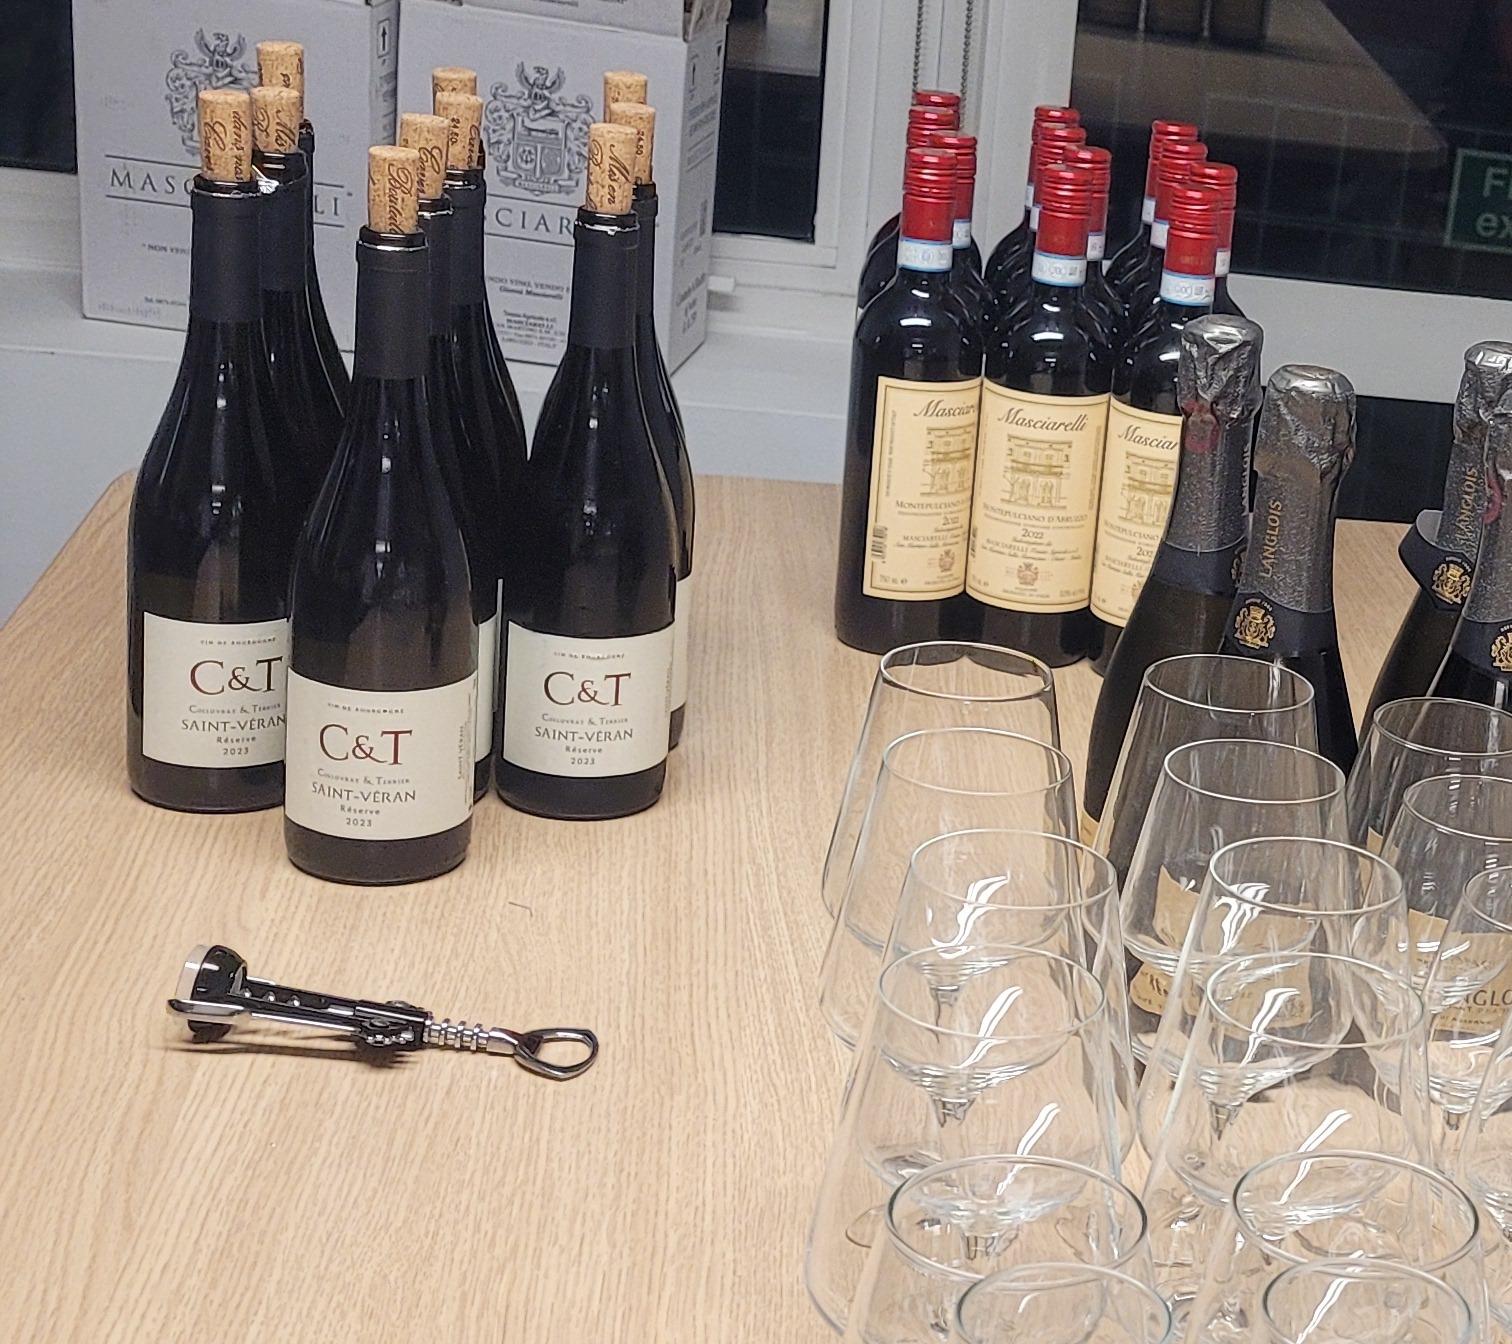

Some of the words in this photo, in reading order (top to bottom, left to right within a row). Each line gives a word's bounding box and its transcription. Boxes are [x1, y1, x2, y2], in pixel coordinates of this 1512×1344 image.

[913, 399, 978, 418] Masciar
[997, 406, 1089, 433] Masciarelli
[1117, 424, 1179, 451] Masciar
[1454, 467, 1478, 545] LANGLOIS
[1020, 528, 1044, 540] 2022
[1259, 500, 1283, 579] LANGLOIS
[1135, 547, 1153, 559] 202
[189, 655, 284, 696] C&T
[543, 670, 632, 708] C&T
[181, 712, 287, 733] SAINT-VÉRAN
[216, 735, 257, 744] Réserve
[318, 722, 414, 766] C&T
[534, 726, 634, 743] SAINT-VÉRAN
[222, 746, 249, 756] 2023
[565, 745, 604, 755] Réserve
[570, 757, 596, 766] 2023
[311, 781, 417, 804] SAINT-VÉRAN
[339, 804, 381, 816] Réserve
[345, 817, 373, 828] 2023
